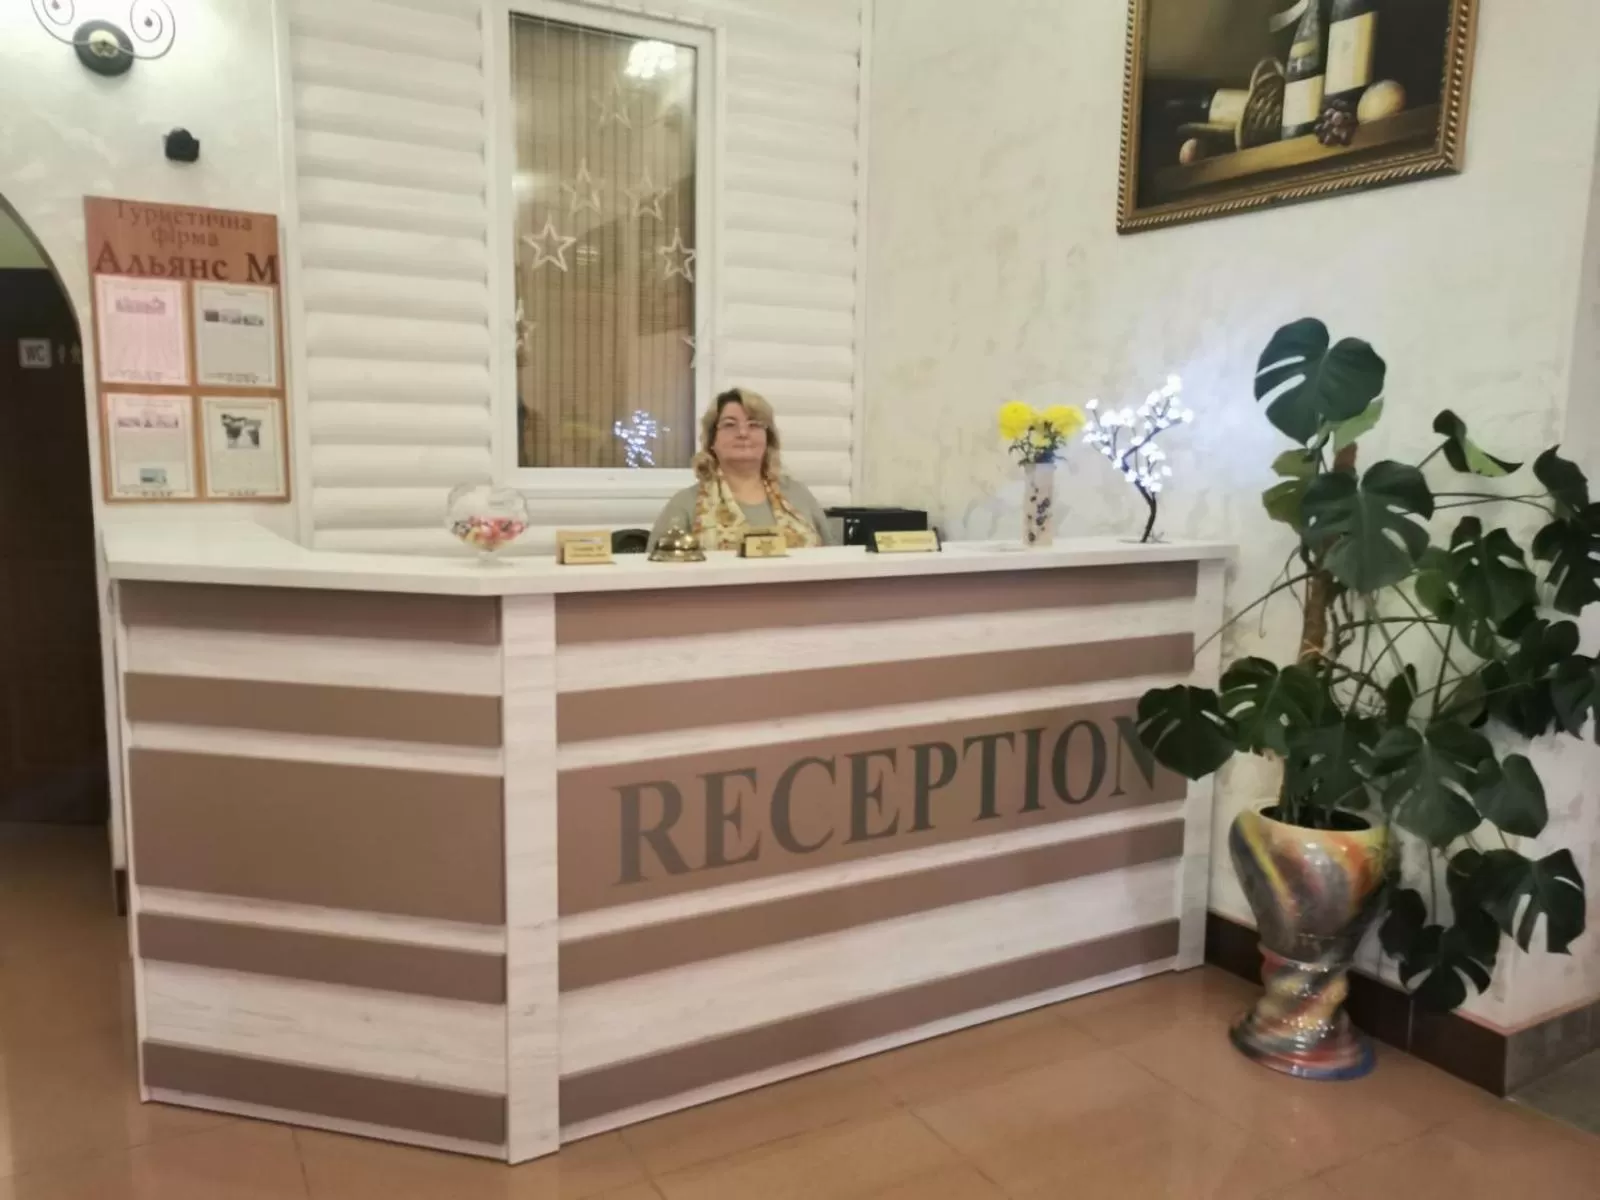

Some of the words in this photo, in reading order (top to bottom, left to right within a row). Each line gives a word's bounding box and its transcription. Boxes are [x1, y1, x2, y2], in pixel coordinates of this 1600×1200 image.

[112, 199, 252, 231] Туристична
[152, 222, 220, 249] фірма
[94, 240, 229, 281] Альянс
[245, 252, 279, 285] М
[610, 715, 1155, 886] RECEPTION
